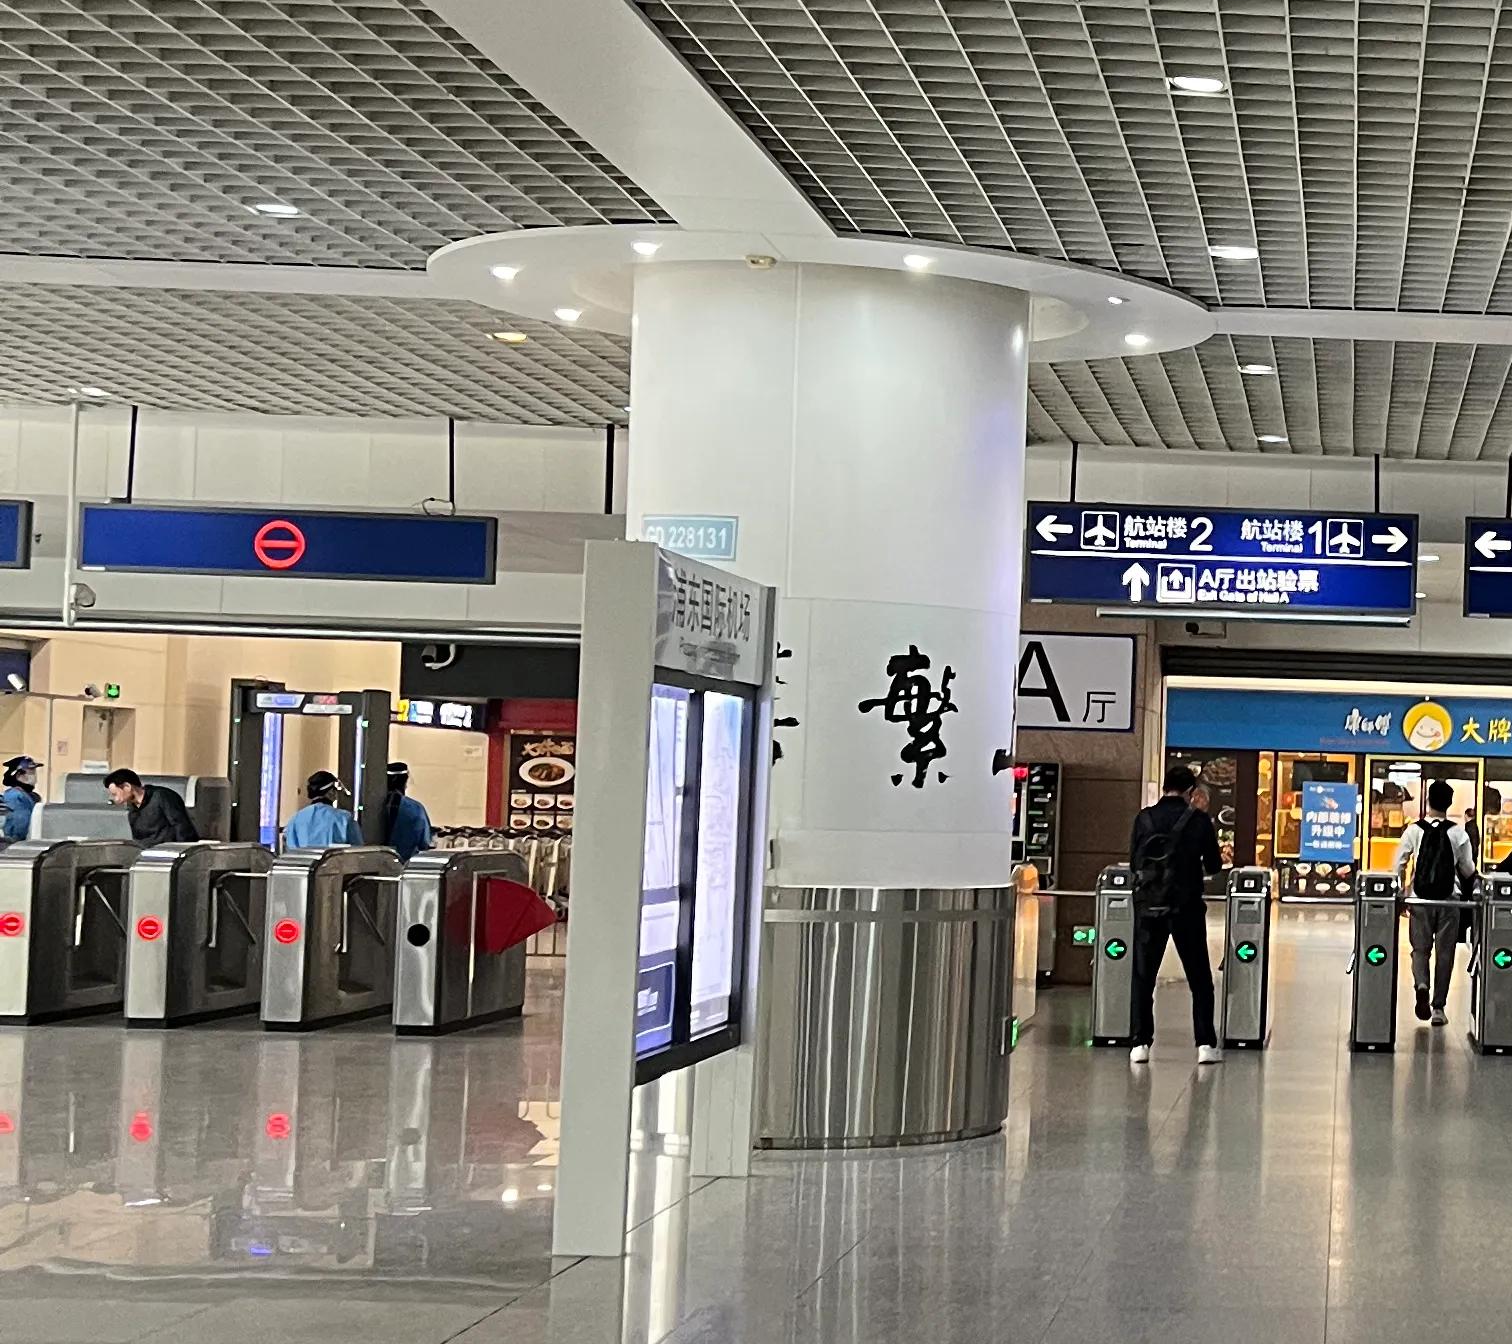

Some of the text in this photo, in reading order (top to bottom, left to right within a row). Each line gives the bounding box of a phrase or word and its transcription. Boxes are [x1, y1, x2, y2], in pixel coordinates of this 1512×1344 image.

[668, 526, 727, 549] 228131
[1124, 515, 1213, 551] 航站楼 2
[1124, 537, 1167, 549] Terminal
[1240, 518, 1322, 555] 航站楼 1
[1261, 541, 1303, 553] Terminal
[673, 567, 751, 642] 浦东国际机场
